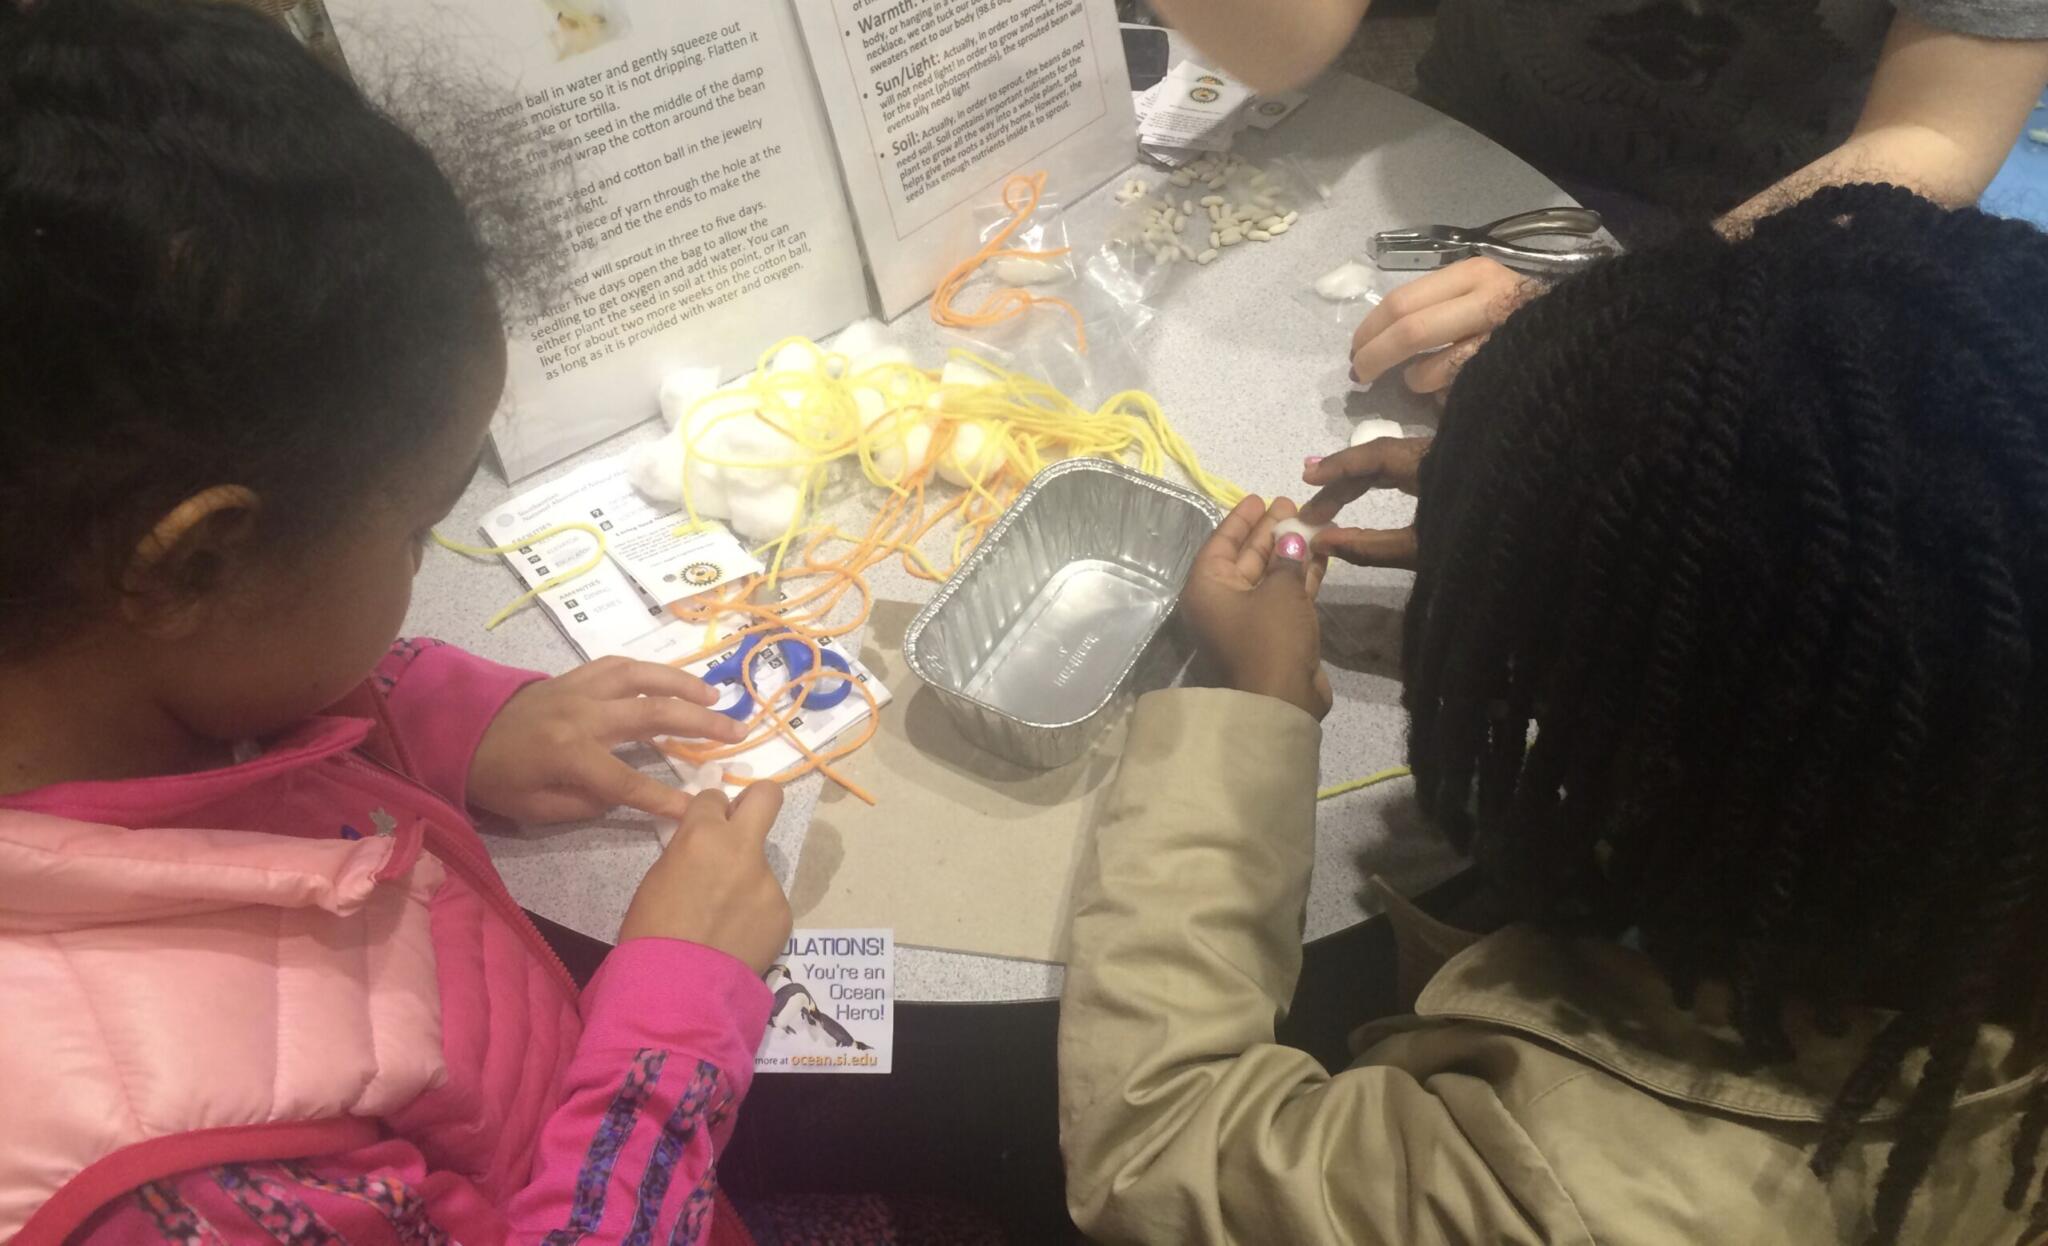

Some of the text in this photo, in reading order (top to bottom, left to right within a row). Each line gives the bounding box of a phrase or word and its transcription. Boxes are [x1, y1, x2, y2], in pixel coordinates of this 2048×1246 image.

[870, 49, 908, 75] sweaters
[910, 38, 927, 53] next
[954, 13, 975, 29] body
[900, 6, 932, 28] hanging
[937, 7, 954, 23] tuck
[525, 22, 741, 107] ball water and gently squeeze out
[531, 97, 586, 123] moisture
[631, 71, 652, 86] not
[708, 38, 747, 58] Flatten
[875, 53, 941, 97] Sun/Light:
[988, 19, 1009, 35] order
[881, 8, 1055, 110] will need order grow make
[914, 88, 934, 108] plant
[1018, 22, 1049, 47] sprouted
[1050, 13, 1068, 28] bean
[550, 82, 765, 171] and wrap the cotton around the bean
[585, 121, 613, 141] seed
[630, 110, 650, 124] the
[654, 93, 693, 115] middle
[709, 80, 729, 94] the
[731, 68, 764, 86] damp
[887, 81, 970, 134] eventually need light
[892, 131, 920, 156] Soil:
[967, 97, 988, 114] order
[1039, 55, 1060, 72] beans
[897, 150, 917, 169] need
[936, 130, 951, 146] Soil
[952, 113, 984, 136] contains
[985, 89, 1023, 117] important
[1024, 71, 1056, 94] nutrients
[900, 162, 920, 183] plant
[932, 145, 952, 164] grow
[954, 136, 963, 148] all
[996, 110, 1011, 123] into
[1019, 92, 1041, 110] whole
[567, 119, 764, 202] seed and cotton ball the jewelry
[576, 146, 781, 237] piece yarn through the hole the
[903, 174, 924, 191] helps
[926, 164, 942, 181] give
[958, 143, 977, 159] roots
[986, 124, 1009, 142] sturdy
[906, 185, 924, 202] seed
[941, 158, 970, 181] enough
[971, 139, 1005, 164] nutrients
[1006, 125, 1028, 142] inside
[601, 223, 623, 241] and
[625, 219, 641, 231] tie
[643, 210, 663, 224] the
[666, 197, 692, 215] ends
[710, 178, 740, 196] make
[742, 169, 761, 183] the
[531, 314, 582, 341] seedling
[600, 296, 618, 315] get
[621, 280, 661, 303] oxygen
[664, 267, 684, 284] and
[687, 256, 708, 274] add
[747, 234, 768, 248] You
[771, 225, 789, 238] can
[593, 262, 613, 279] will
[616, 246, 654, 270] sprout
[668, 229, 699, 248] three
[715, 214, 736, 228] five
[598, 279, 625, 296] days
[628, 265, 657, 283] open
[659, 256, 679, 270] the
[681, 246, 703, 261] bag
[719, 227, 748, 245] allow
[750, 218, 768, 232] the
[536, 332, 572, 354] either
[575, 316, 605, 340] plant
[607, 309, 627, 323] the
[630, 293, 656, 313] seed
[672, 278, 692, 295] soil
[707, 265, 728, 280] this
[788, 231, 806, 245] can
[539, 352, 562, 367] live
[564, 344, 582, 357] for
[585, 326, 619, 348] about
[621, 317, 644, 332] two
[647, 302, 676, 321] more
[679, 286, 714, 307] weeks
[732, 270, 750, 284] the
[753, 254, 787, 275] cotton
[560, 356, 588, 374] long
[628, 314, 677, 347] provided
[681, 302, 704, 321] with
[708, 290, 738, 309] water
[741, 277, 761, 294] and
[803, 963, 885, 980] You're an
[830, 983, 885, 1000] Ocean
[836, 1004, 884, 1020] Hero!
[780, 1056, 788, 1065] at
[791, 1053, 878, 1066] ocean.si.edu
